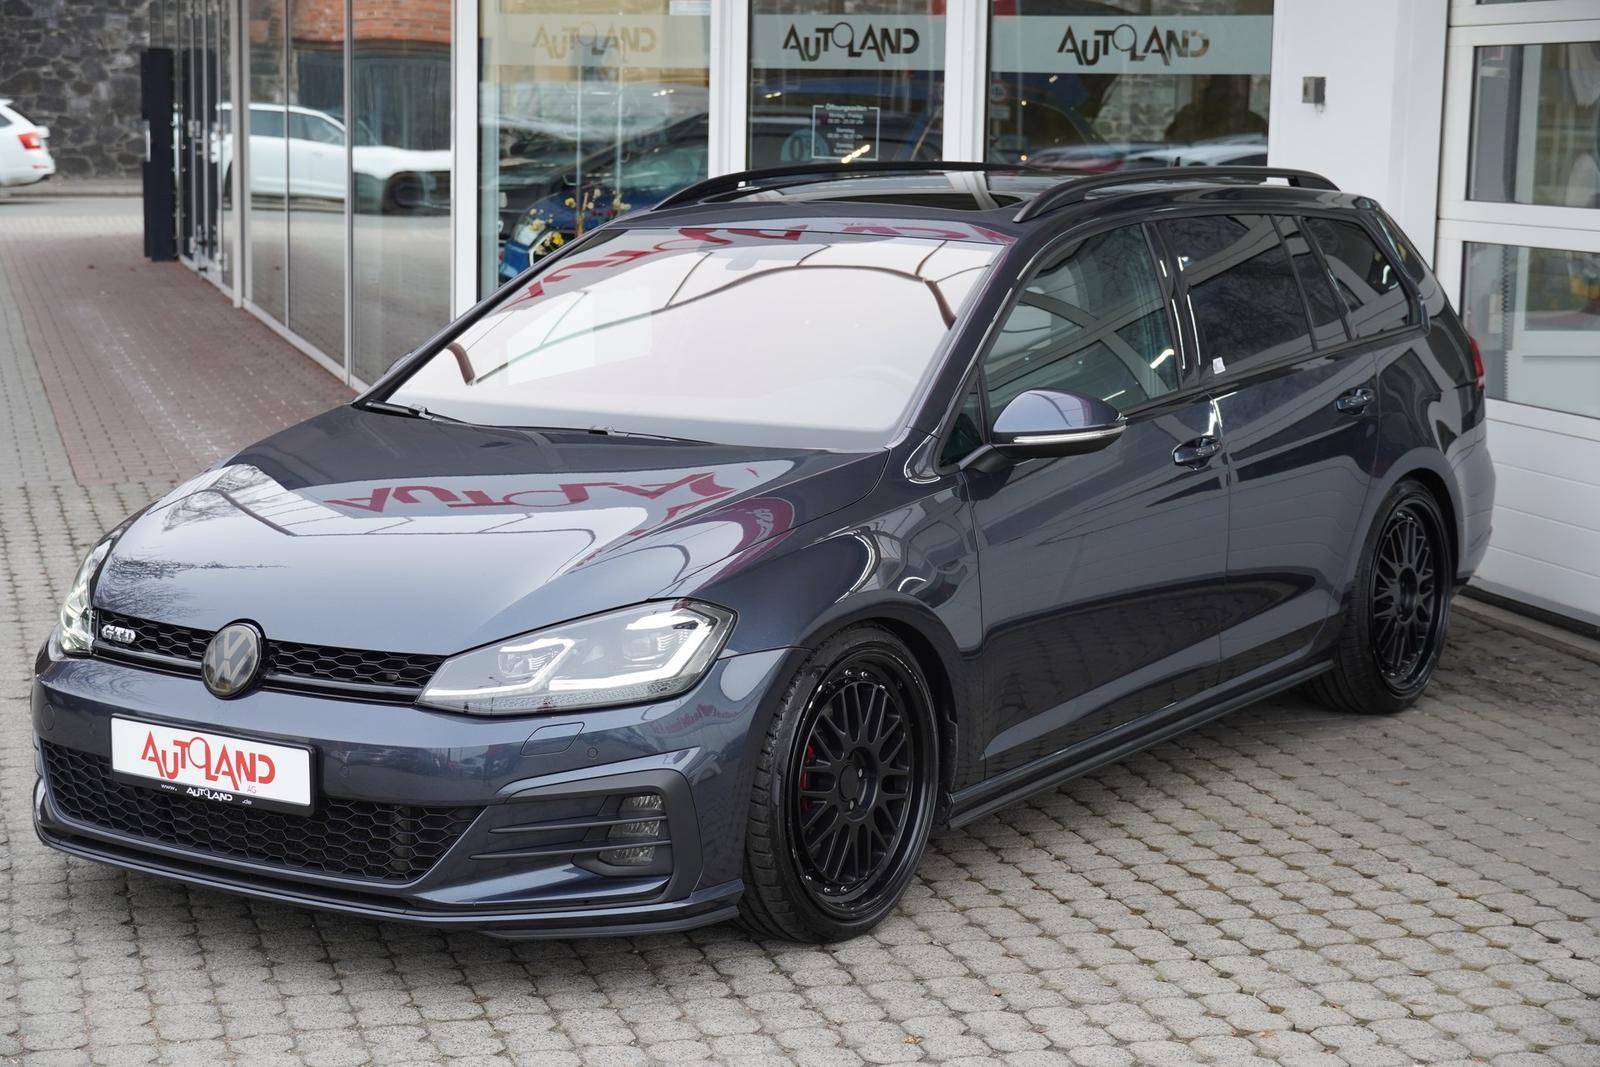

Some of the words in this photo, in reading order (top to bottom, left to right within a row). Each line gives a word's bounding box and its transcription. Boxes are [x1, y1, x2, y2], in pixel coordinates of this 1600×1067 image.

[531, 21, 658, 61] AUTOLAND
[782, 21, 920, 62] AUTOLAND
[1057, 23, 1210, 66] AUTOLAND
[101, 624, 136, 644] GTD
[141, 730, 276, 791] AUTOLAND
[186, 786, 233, 802] AUTOLAND
[246, 785, 257, 794] AG
